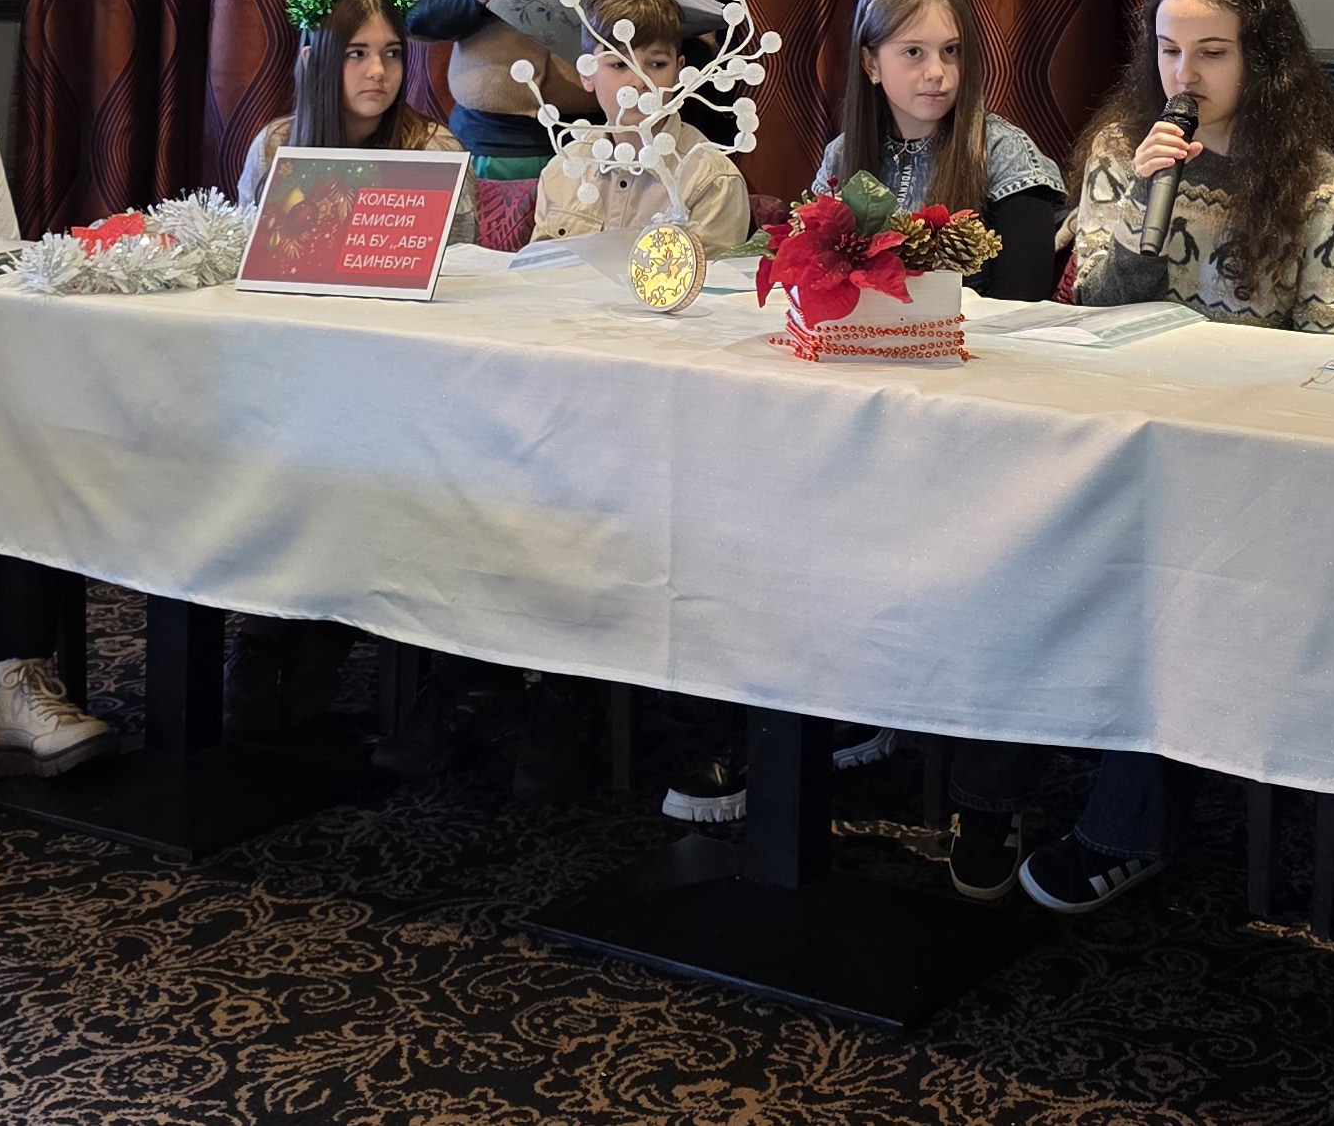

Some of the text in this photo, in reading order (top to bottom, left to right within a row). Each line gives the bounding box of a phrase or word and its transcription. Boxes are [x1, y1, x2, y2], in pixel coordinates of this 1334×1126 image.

[357, 192, 426, 209] КОЛЕДНА
[352, 213, 416, 228] ЕМИСИЯ
[345, 234, 366, 247] НА
[369, 234, 389, 247] БУ
[343, 253, 422, 270] ЕДИНБУРГ
